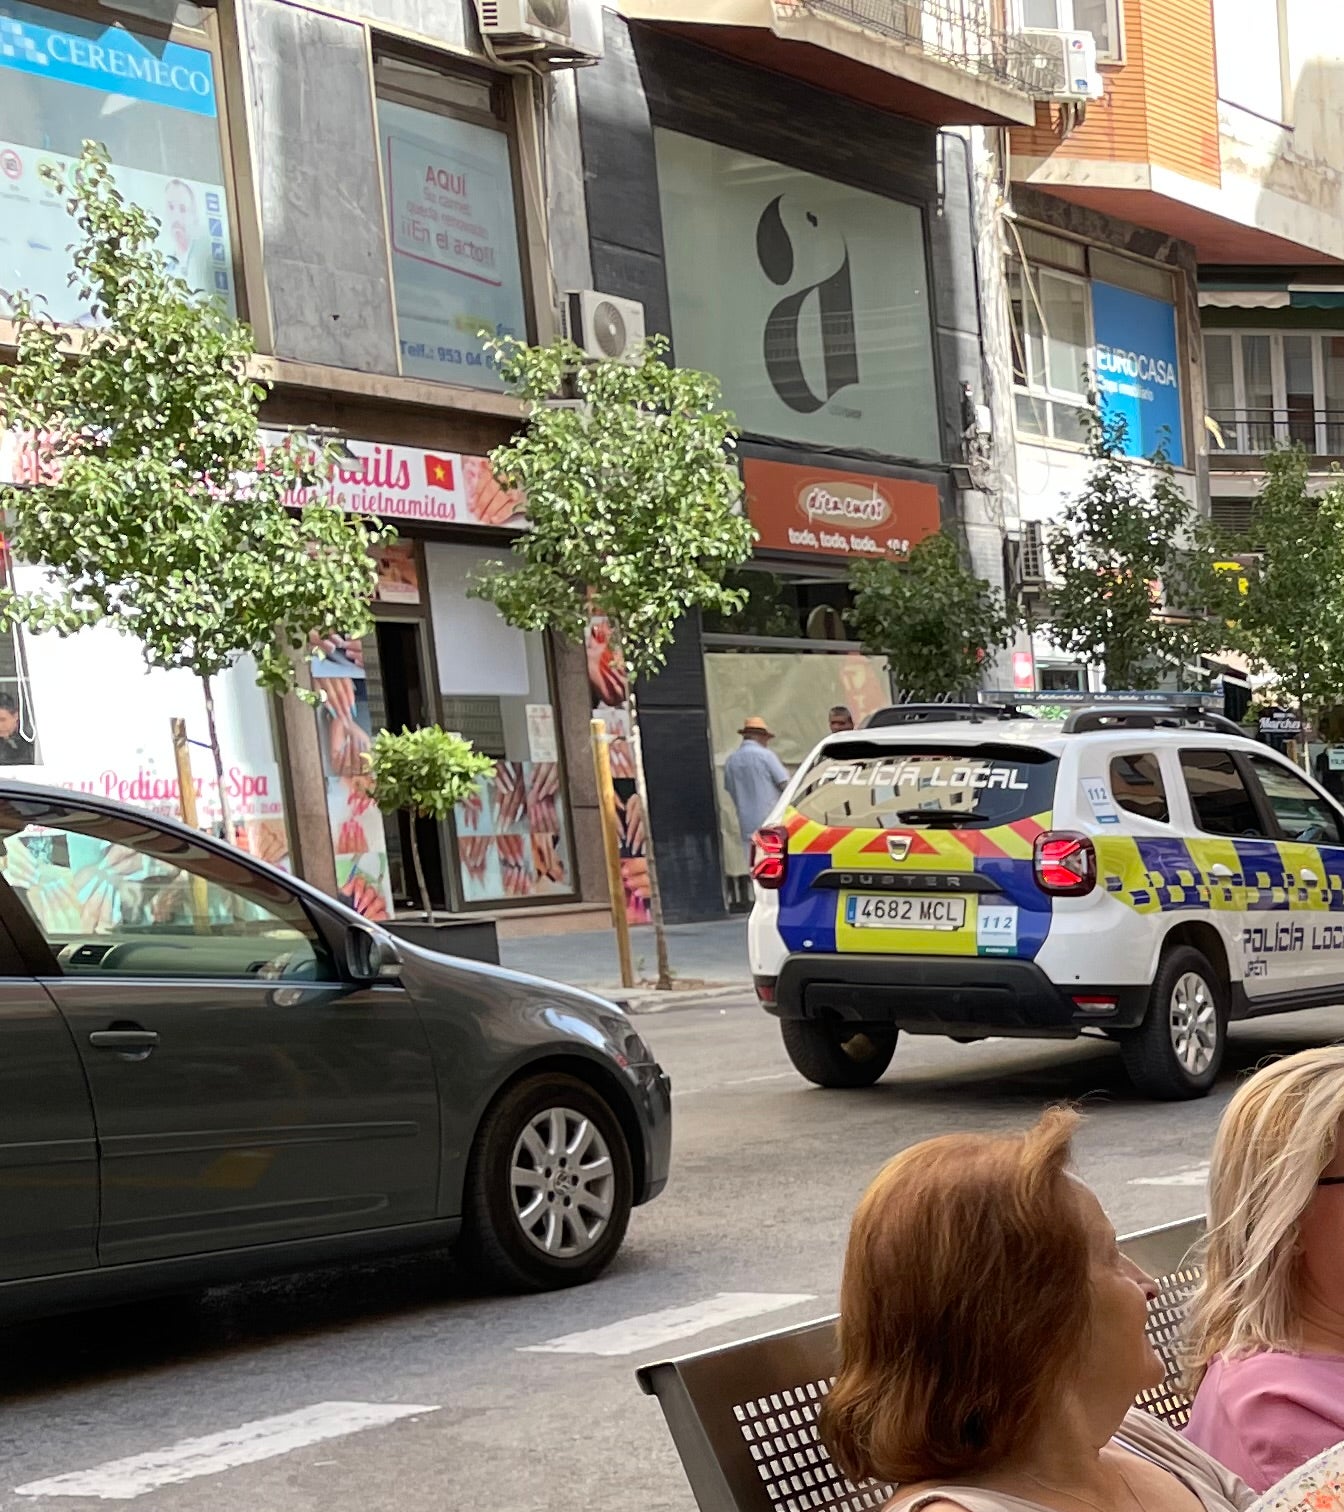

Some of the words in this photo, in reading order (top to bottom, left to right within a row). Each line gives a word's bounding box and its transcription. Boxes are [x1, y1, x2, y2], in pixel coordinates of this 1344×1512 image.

[46, 34, 210, 96] CEREMECO
[1095, 343, 1177, 388] EUROCASA
[788, 527, 818, 549] todo,
[820, 531, 850, 552] todo,
[100, 769, 204, 803] Pedicua
[228, 767, 268, 799] Spa
[930, 766, 1029, 790] LOCAL
[1087, 787, 1108, 800] 112
[840, 875, 961, 888] DUSTER
[861, 899, 912, 921] 4682
[918, 901, 959, 922] MCL
[982, 915, 1013, 929] 112
